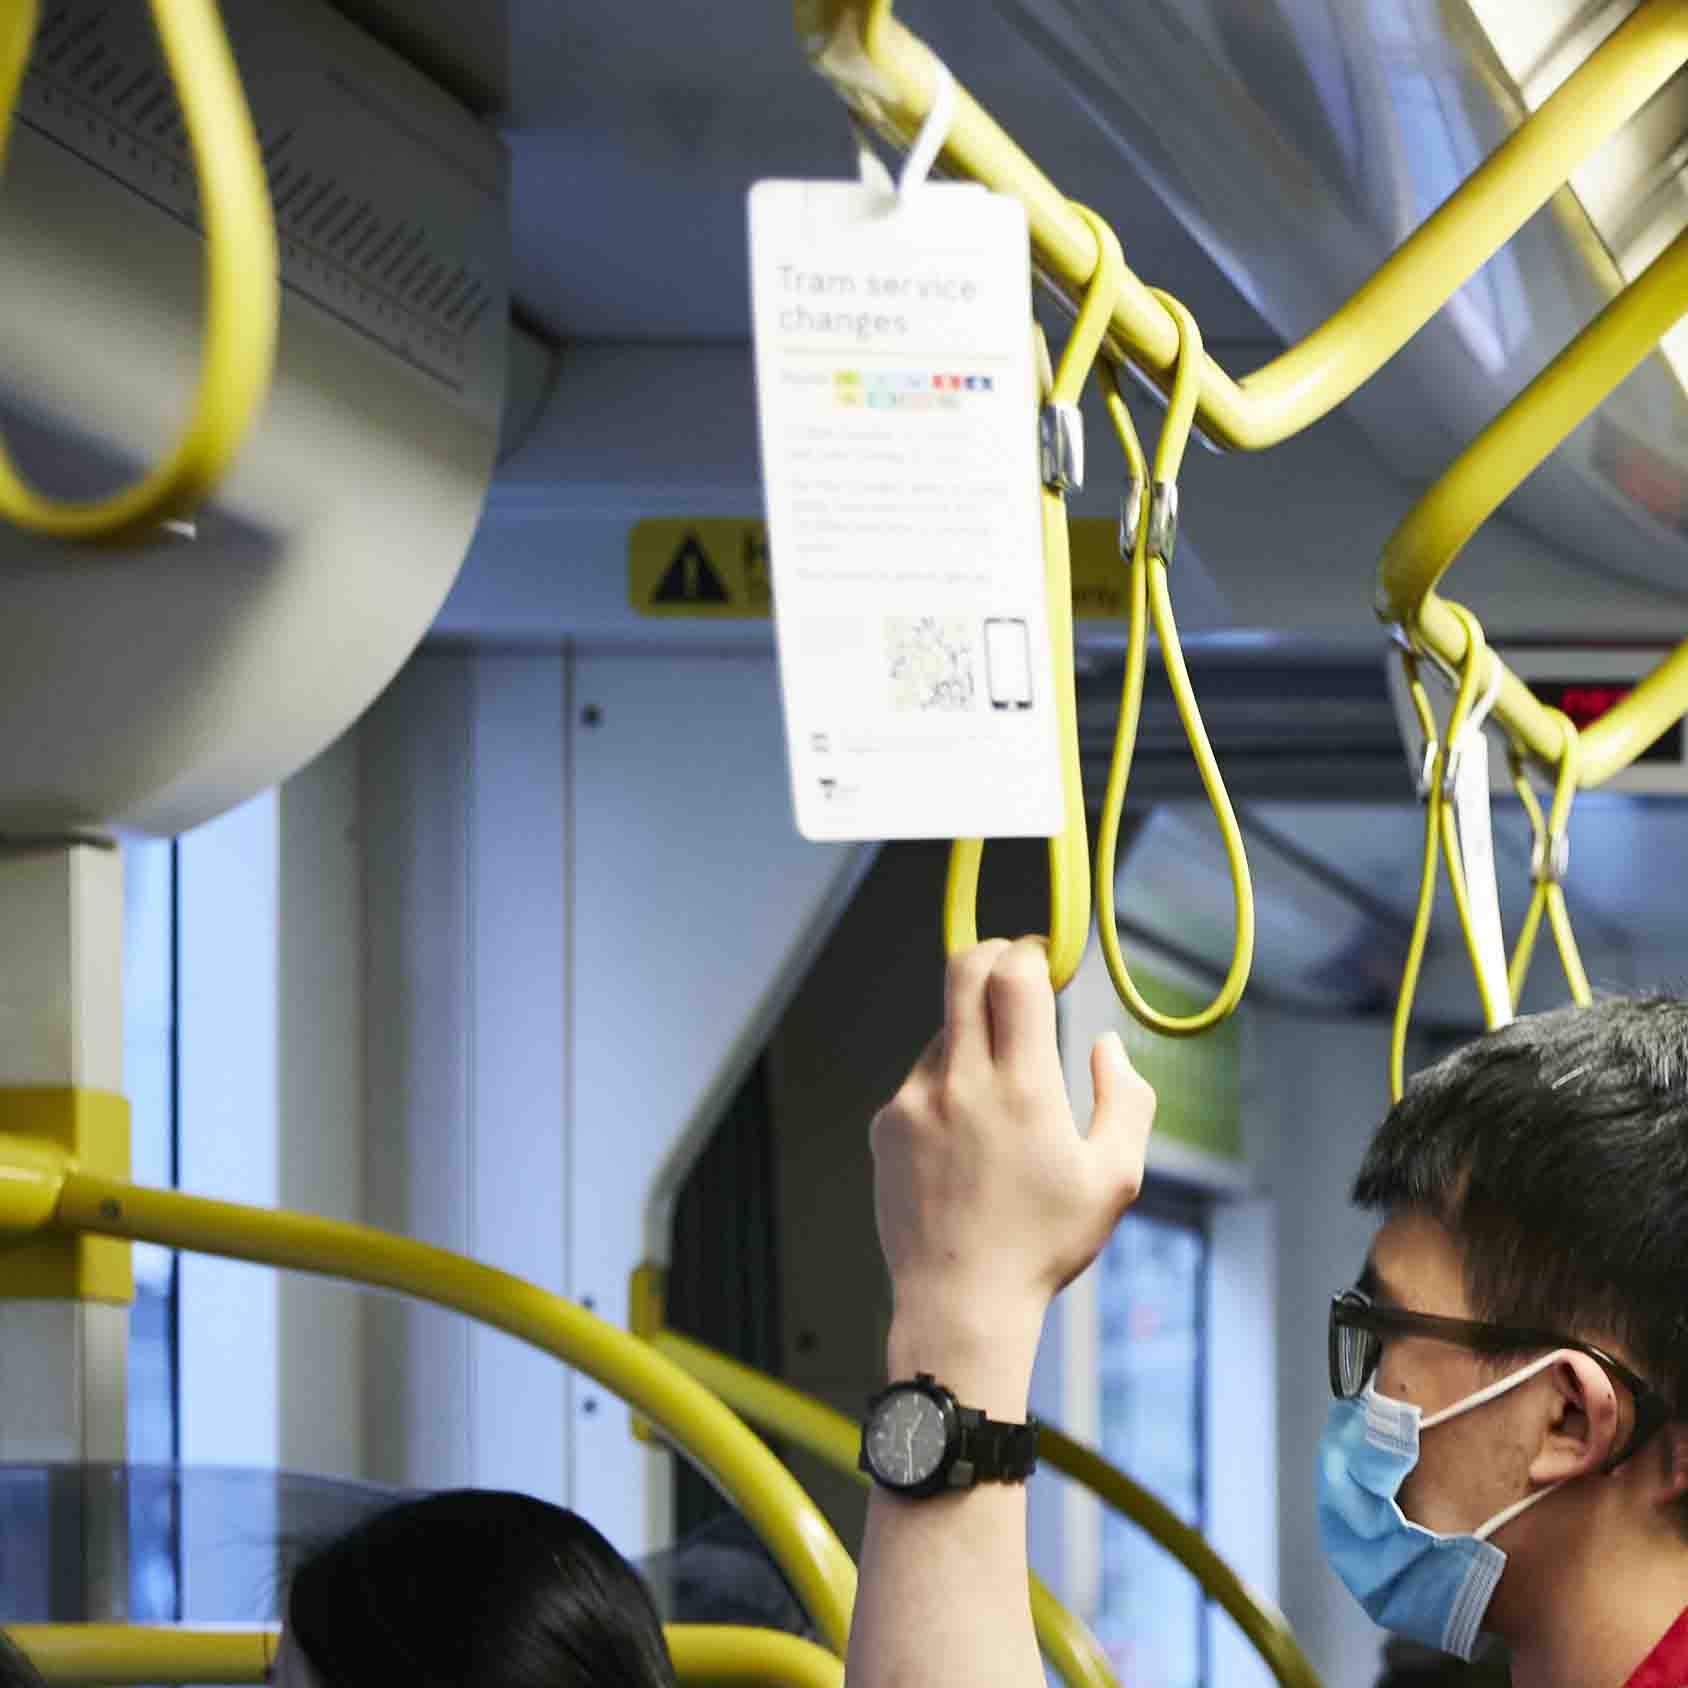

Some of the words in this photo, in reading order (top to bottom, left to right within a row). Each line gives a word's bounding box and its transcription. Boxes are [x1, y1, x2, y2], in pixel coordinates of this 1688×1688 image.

[776, 264, 857, 297] Tram
[866, 274, 977, 303] service
[778, 304, 909, 343] changes
